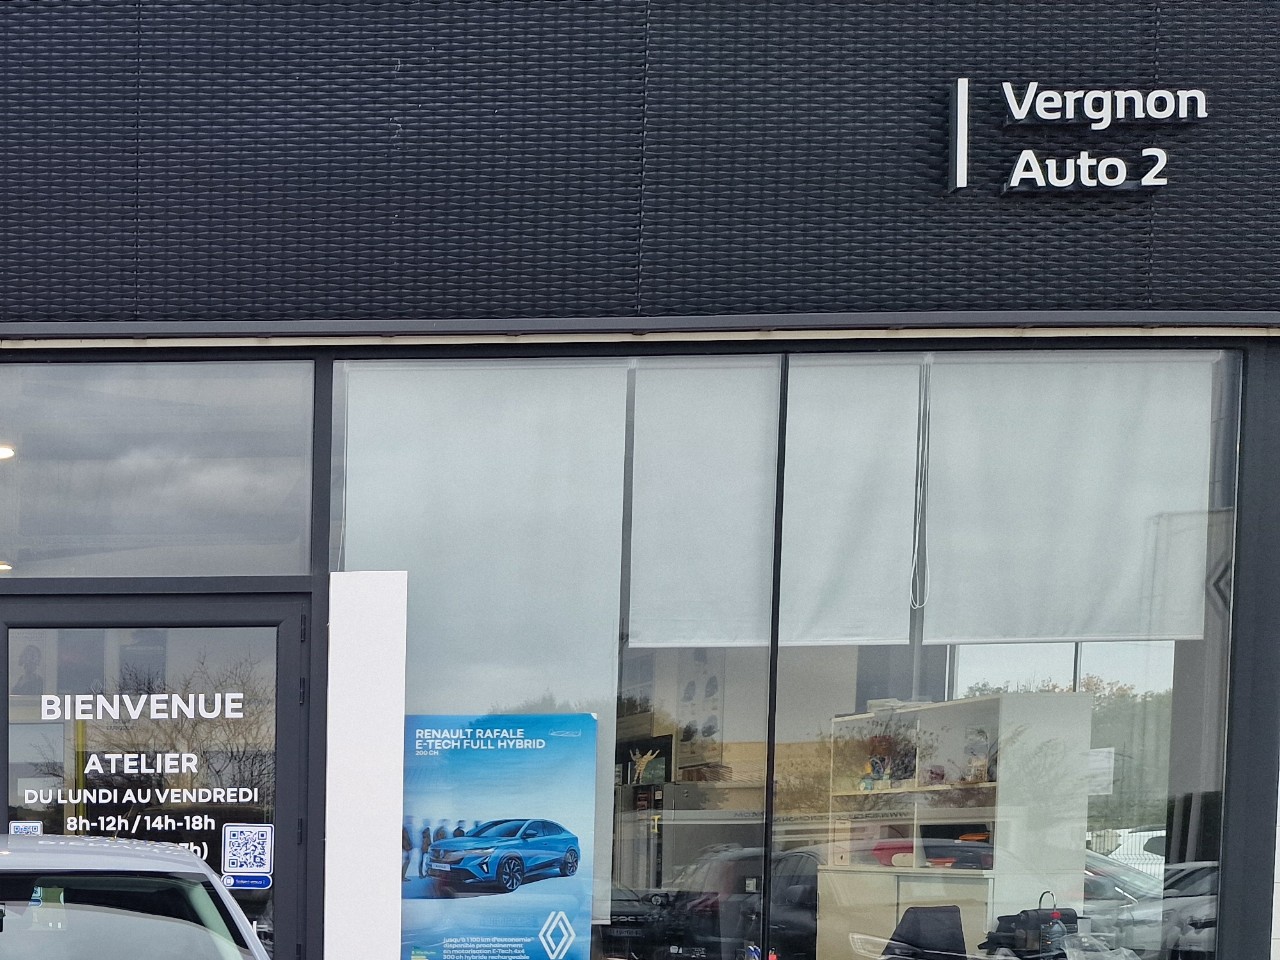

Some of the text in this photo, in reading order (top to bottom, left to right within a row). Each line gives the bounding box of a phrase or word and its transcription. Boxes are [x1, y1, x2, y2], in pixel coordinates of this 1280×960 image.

[1002, 81, 1208, 130] Vergnon
[1010, 148, 1168, 187] Auto 2
[41, 693, 245, 720] BIENVENUE
[416, 729, 525, 739] RENAULT RAFALE
[415, 739, 546, 749] E-TECH FULL HYBRID
[84, 753, 198, 774] ATELIER
[24, 788, 259, 804] DU LUNDI AU VENDREDI
[66, 816, 129, 831] 8h-12h
[144, 815, 216, 831] 14h-18h
